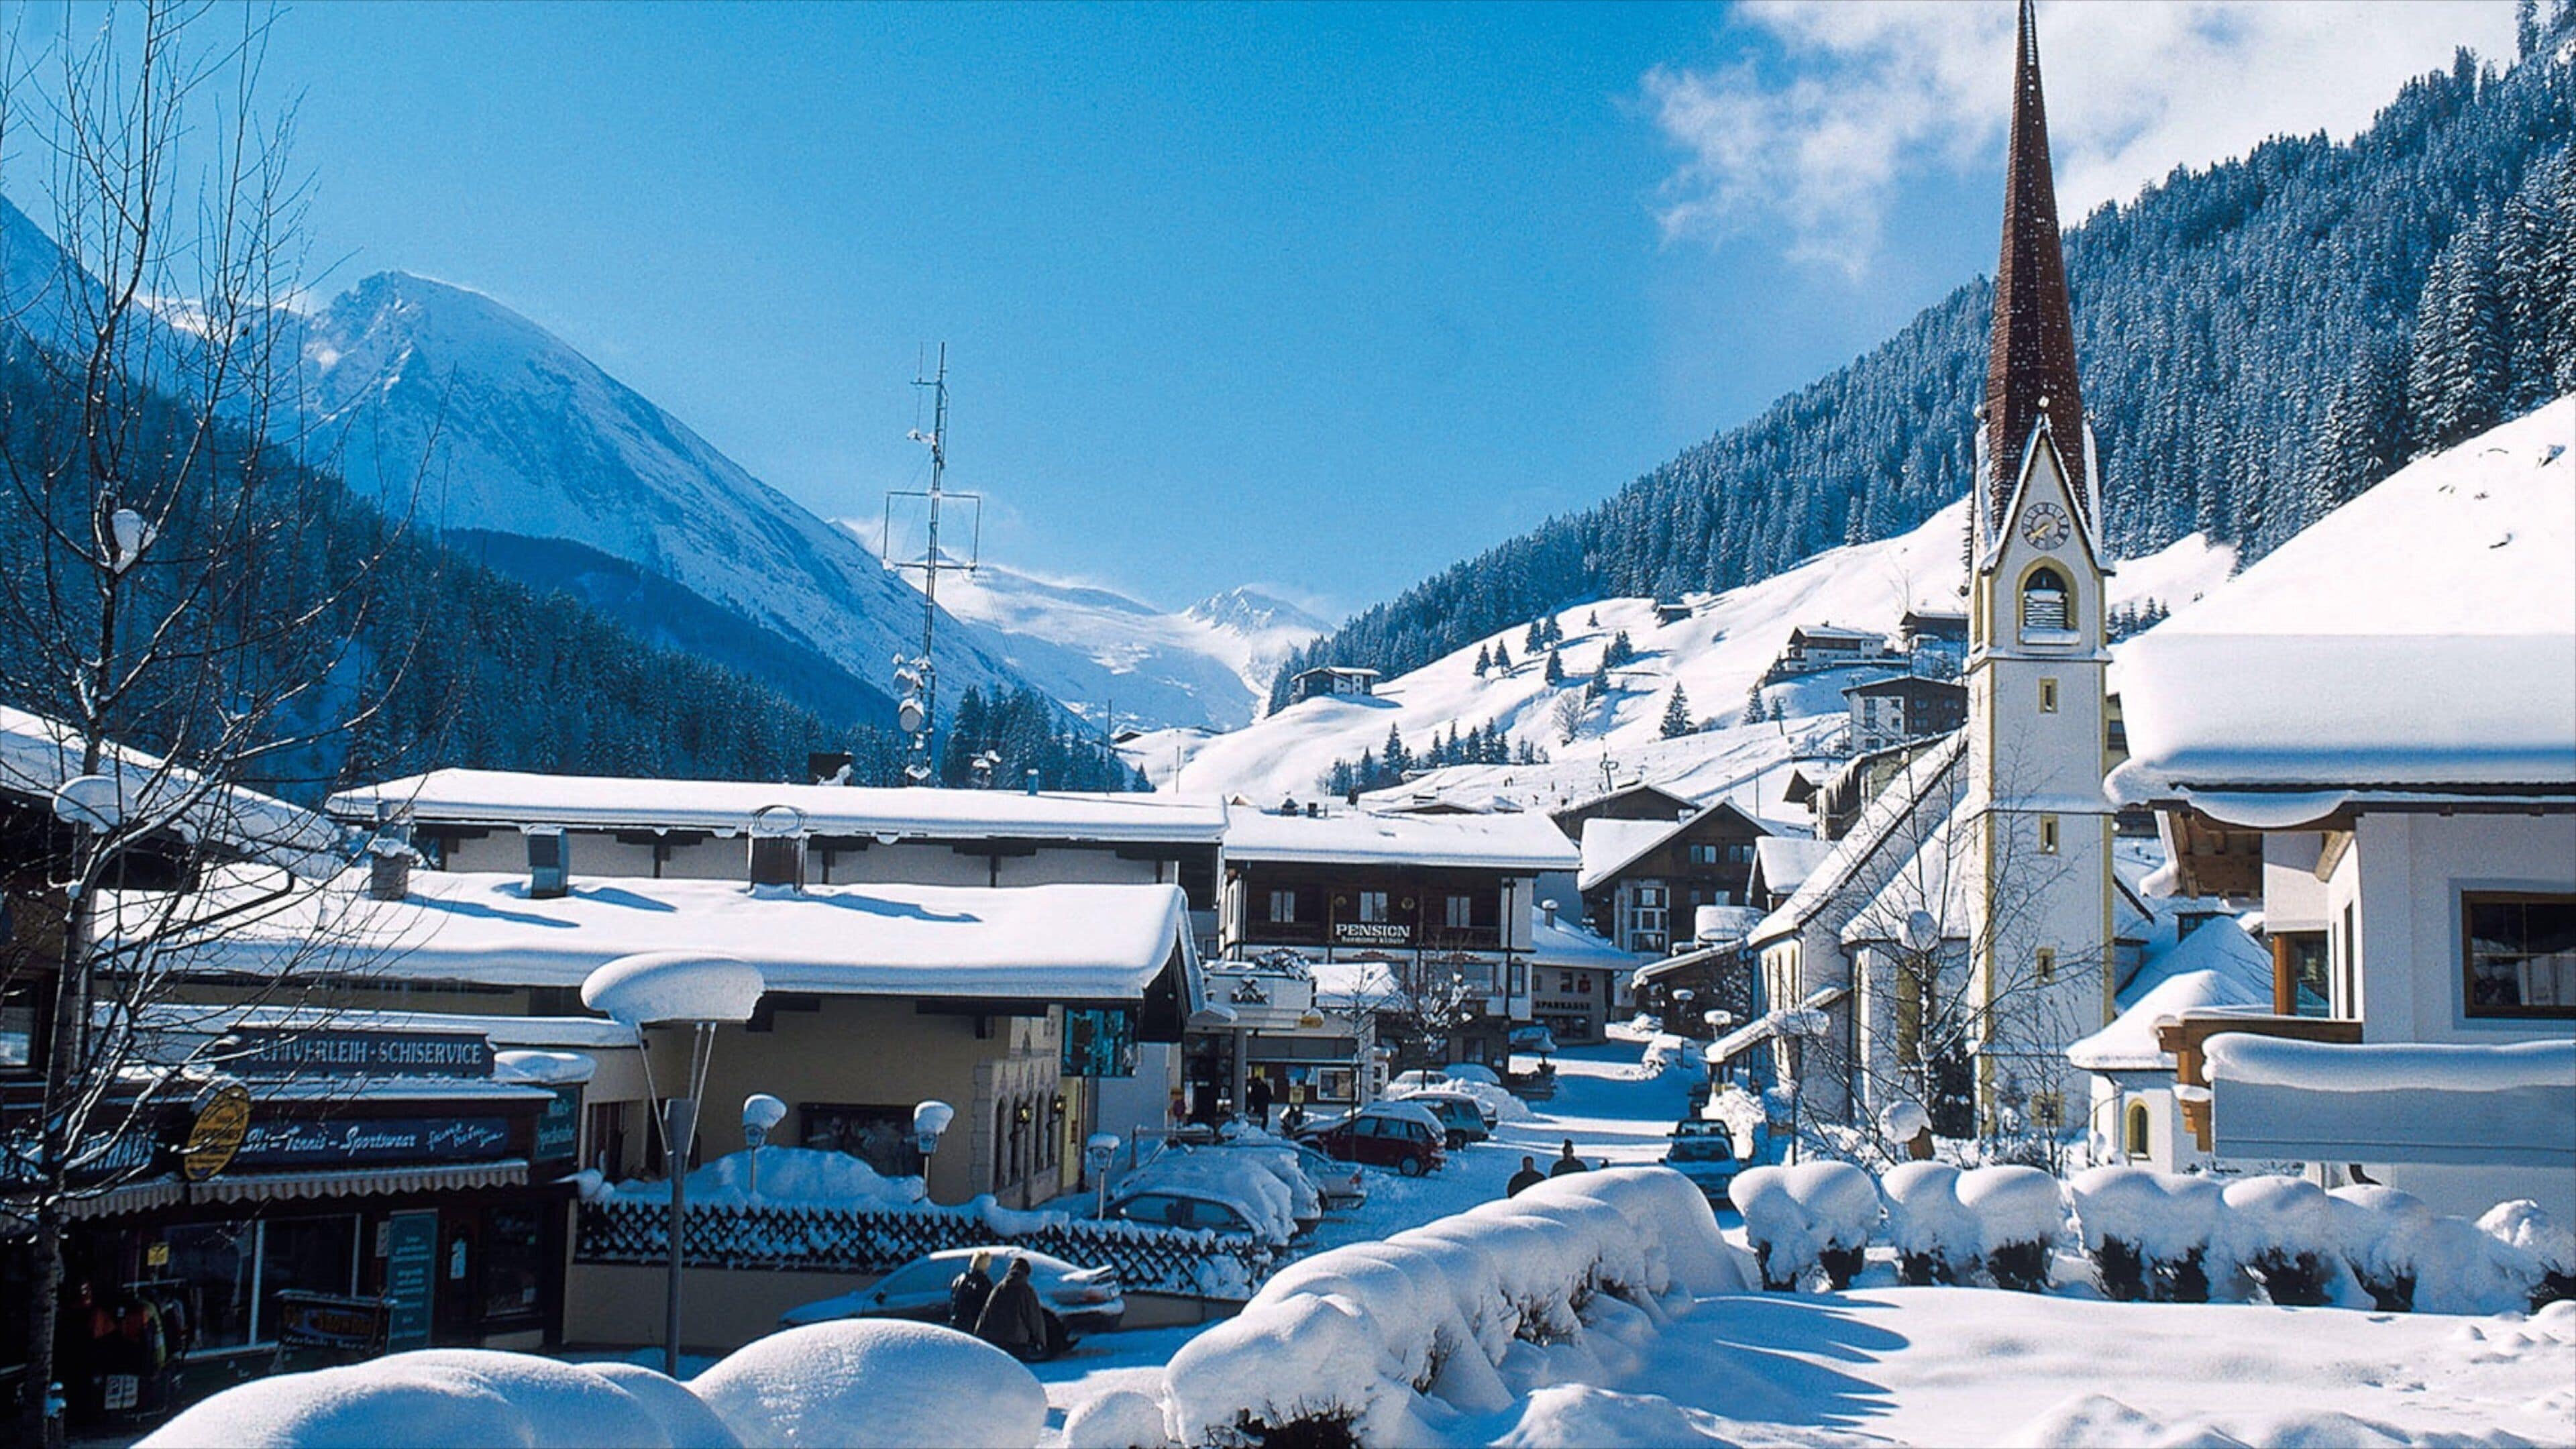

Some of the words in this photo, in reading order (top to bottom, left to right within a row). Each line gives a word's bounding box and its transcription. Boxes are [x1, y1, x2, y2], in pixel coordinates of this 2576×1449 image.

[1336, 924, 1411, 938] PENSION
[379, 1040, 483, 1065] SCHISERVICE
[339, 1125, 418, 1158] Sportswear
